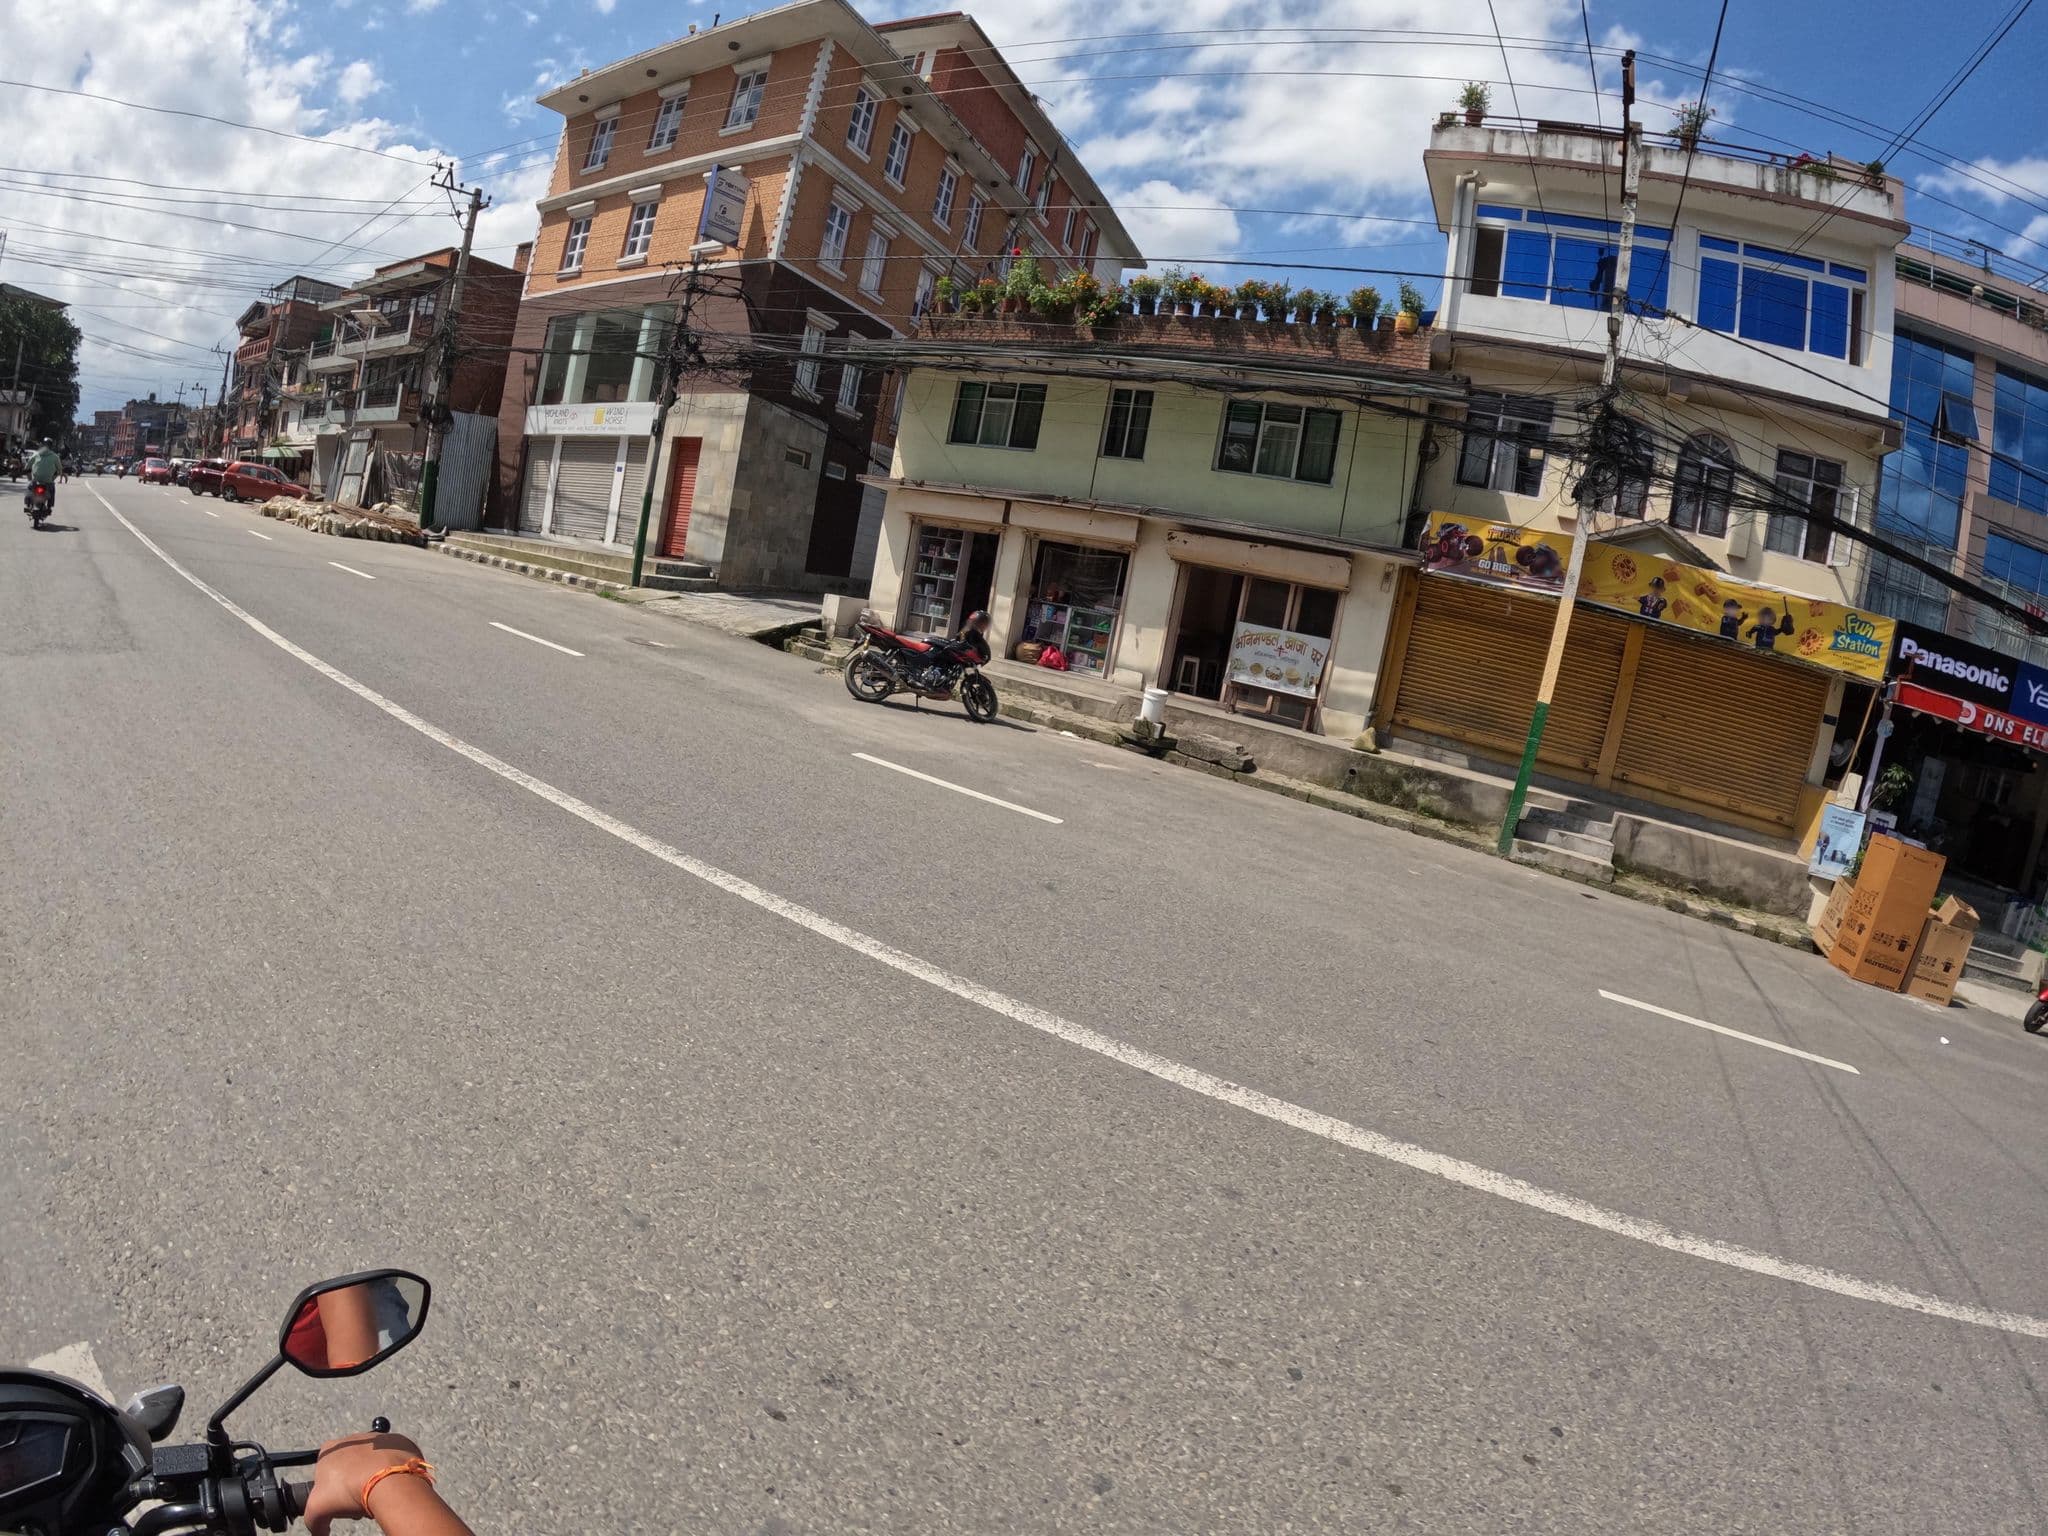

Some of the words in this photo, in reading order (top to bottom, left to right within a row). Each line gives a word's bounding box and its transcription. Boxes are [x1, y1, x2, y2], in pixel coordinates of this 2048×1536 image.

[1478, 560, 1491, 569] GO
[1492, 562, 1511, 574] BIG!
[1846, 613, 1875, 639] Fun
[1837, 634, 1878, 656] Station
[1899, 637, 2010, 693] Panasonic
[1983, 713, 2015, 735] DNS
